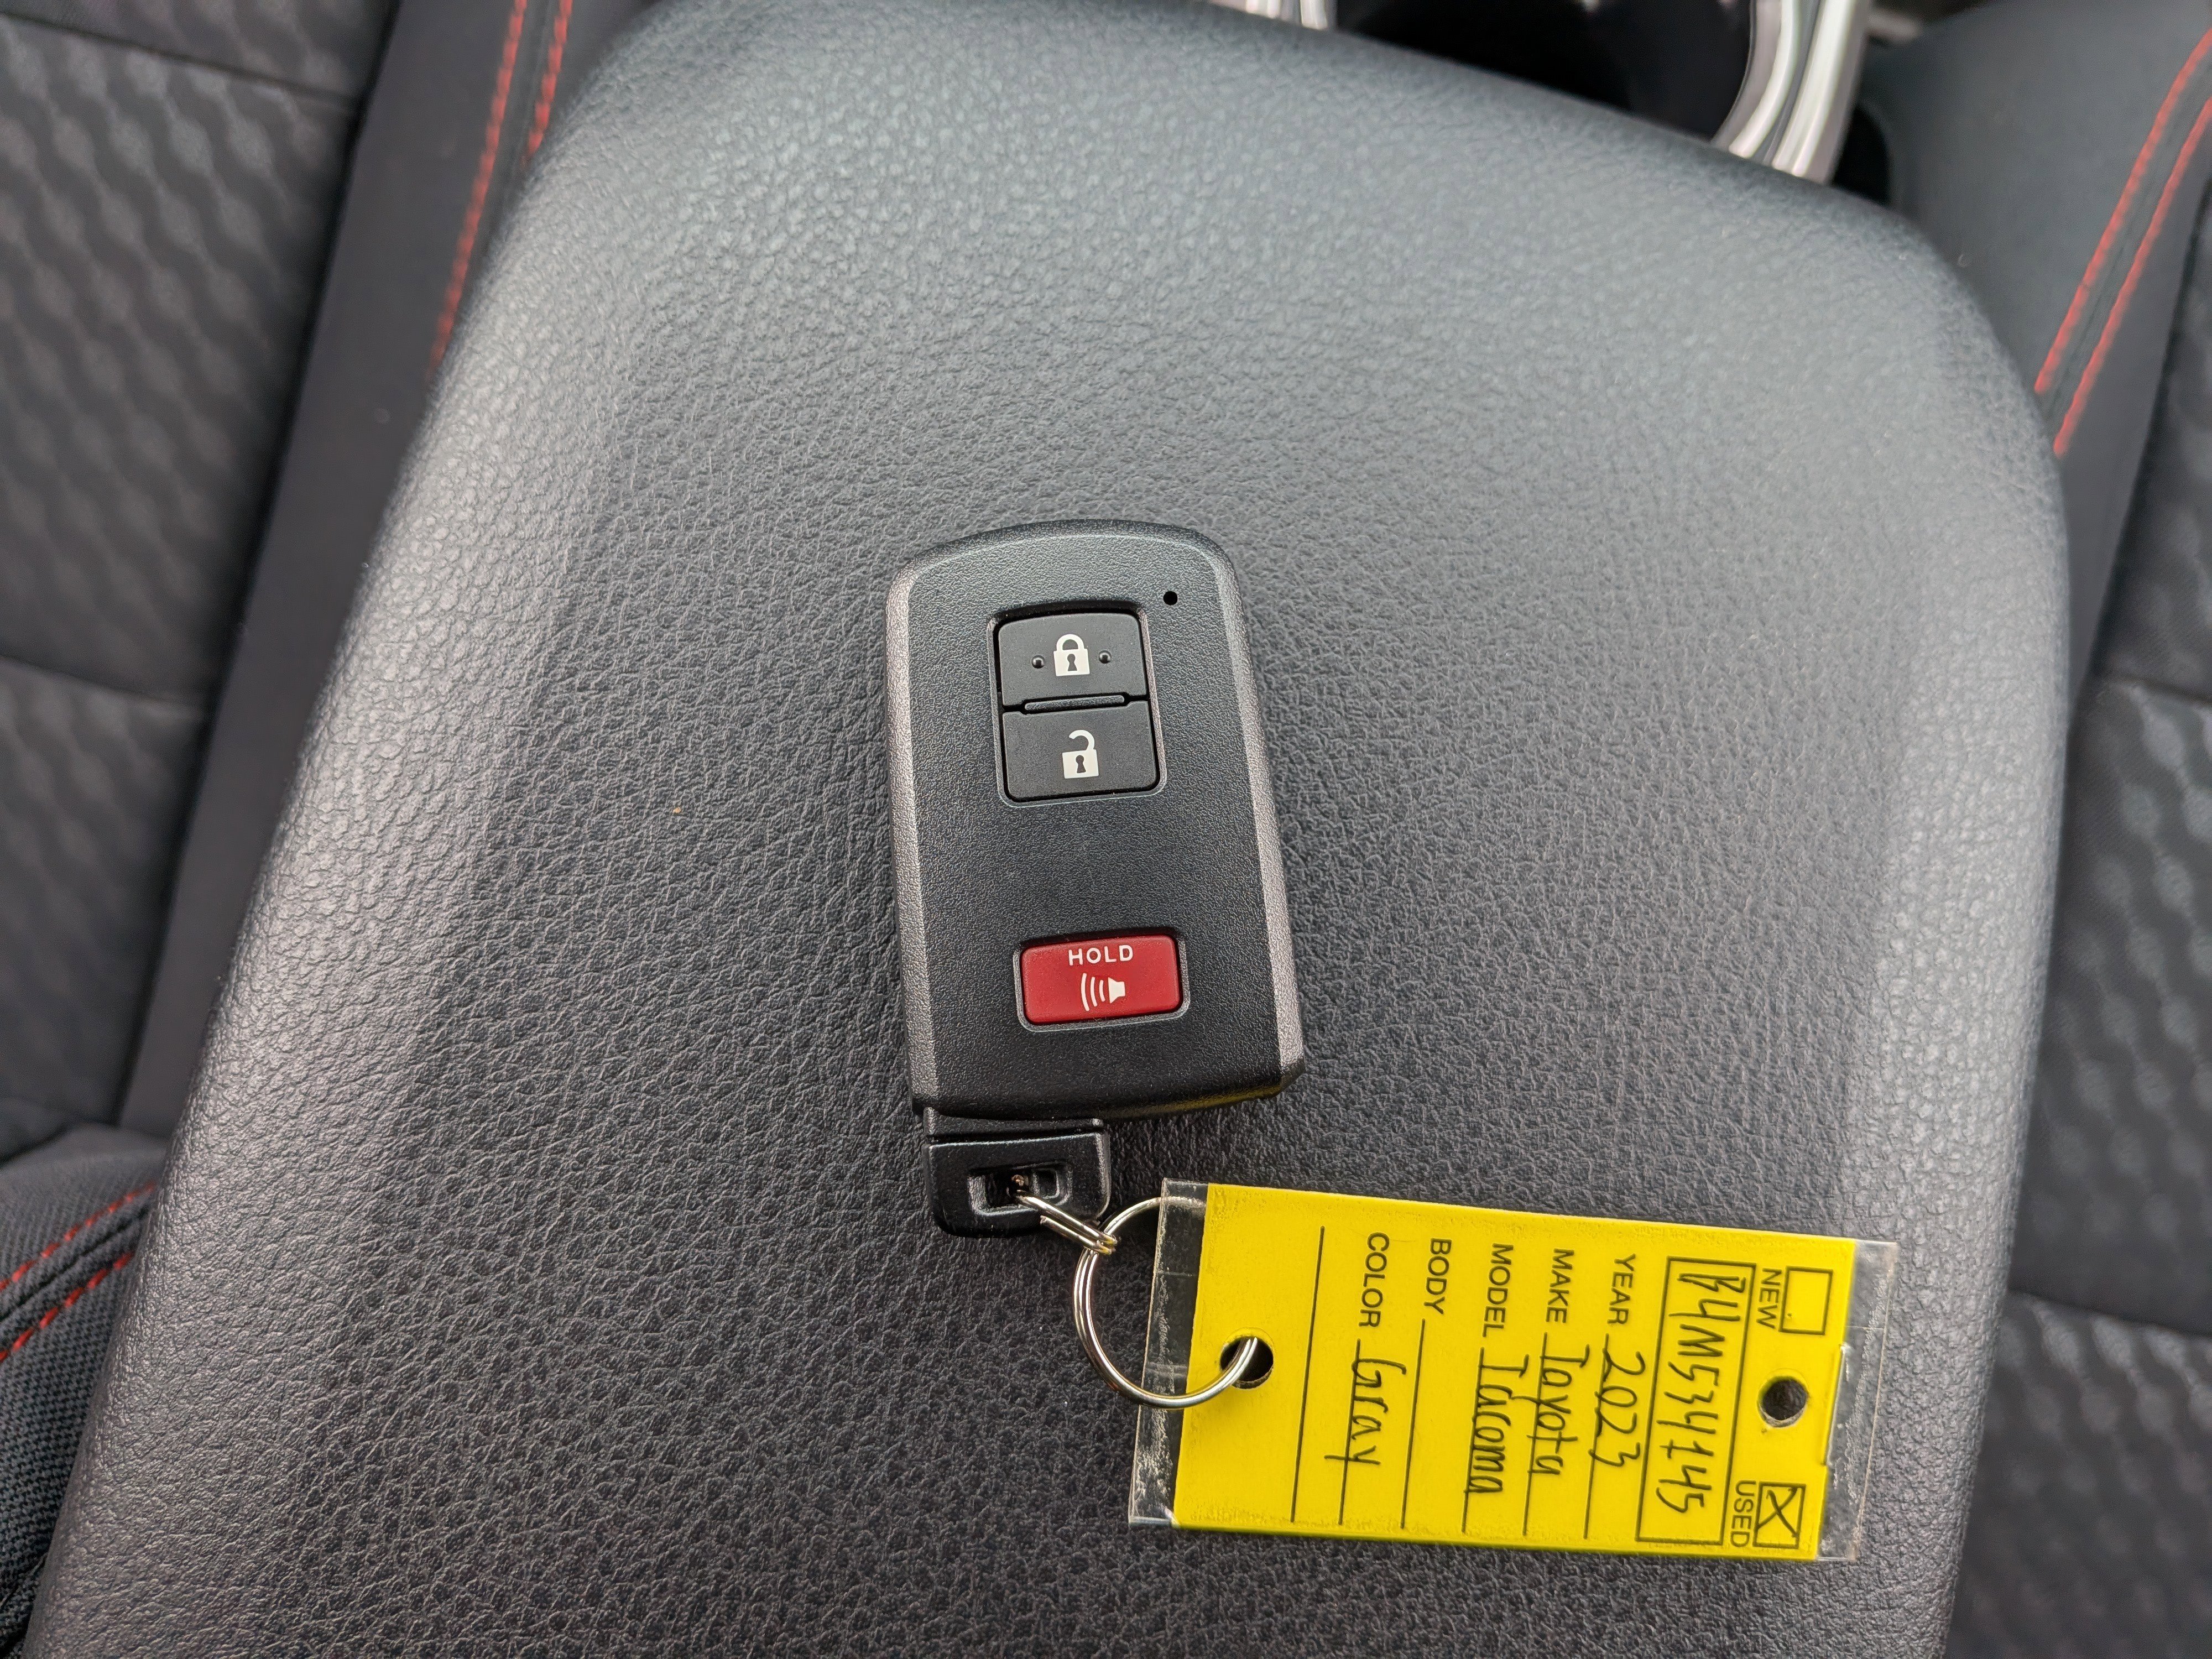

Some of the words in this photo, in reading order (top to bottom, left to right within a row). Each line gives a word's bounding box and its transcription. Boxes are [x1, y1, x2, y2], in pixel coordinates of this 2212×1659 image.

[1068, 943, 1134, 967] HOLD
[1358, 1232, 1390, 1328] COLOR
[1424, 1238, 1452, 1314] BODY
[1482, 1243, 1514, 1338] MODEL
[1545, 1248, 1574, 1324] MAKE
[1607, 1254, 1636, 1326] YEAR
[1756, 1268, 1782, 1329] NEW
[1324, 1357, 1407, 1467] Gray
[1464, 1354, 1529, 1494] Tacoma
[1511, 1344, 1590, 1475] Toyota
[1589, 1347, 1646, 1468] 2023
[1730, 1480, 1756, 1547] USED
